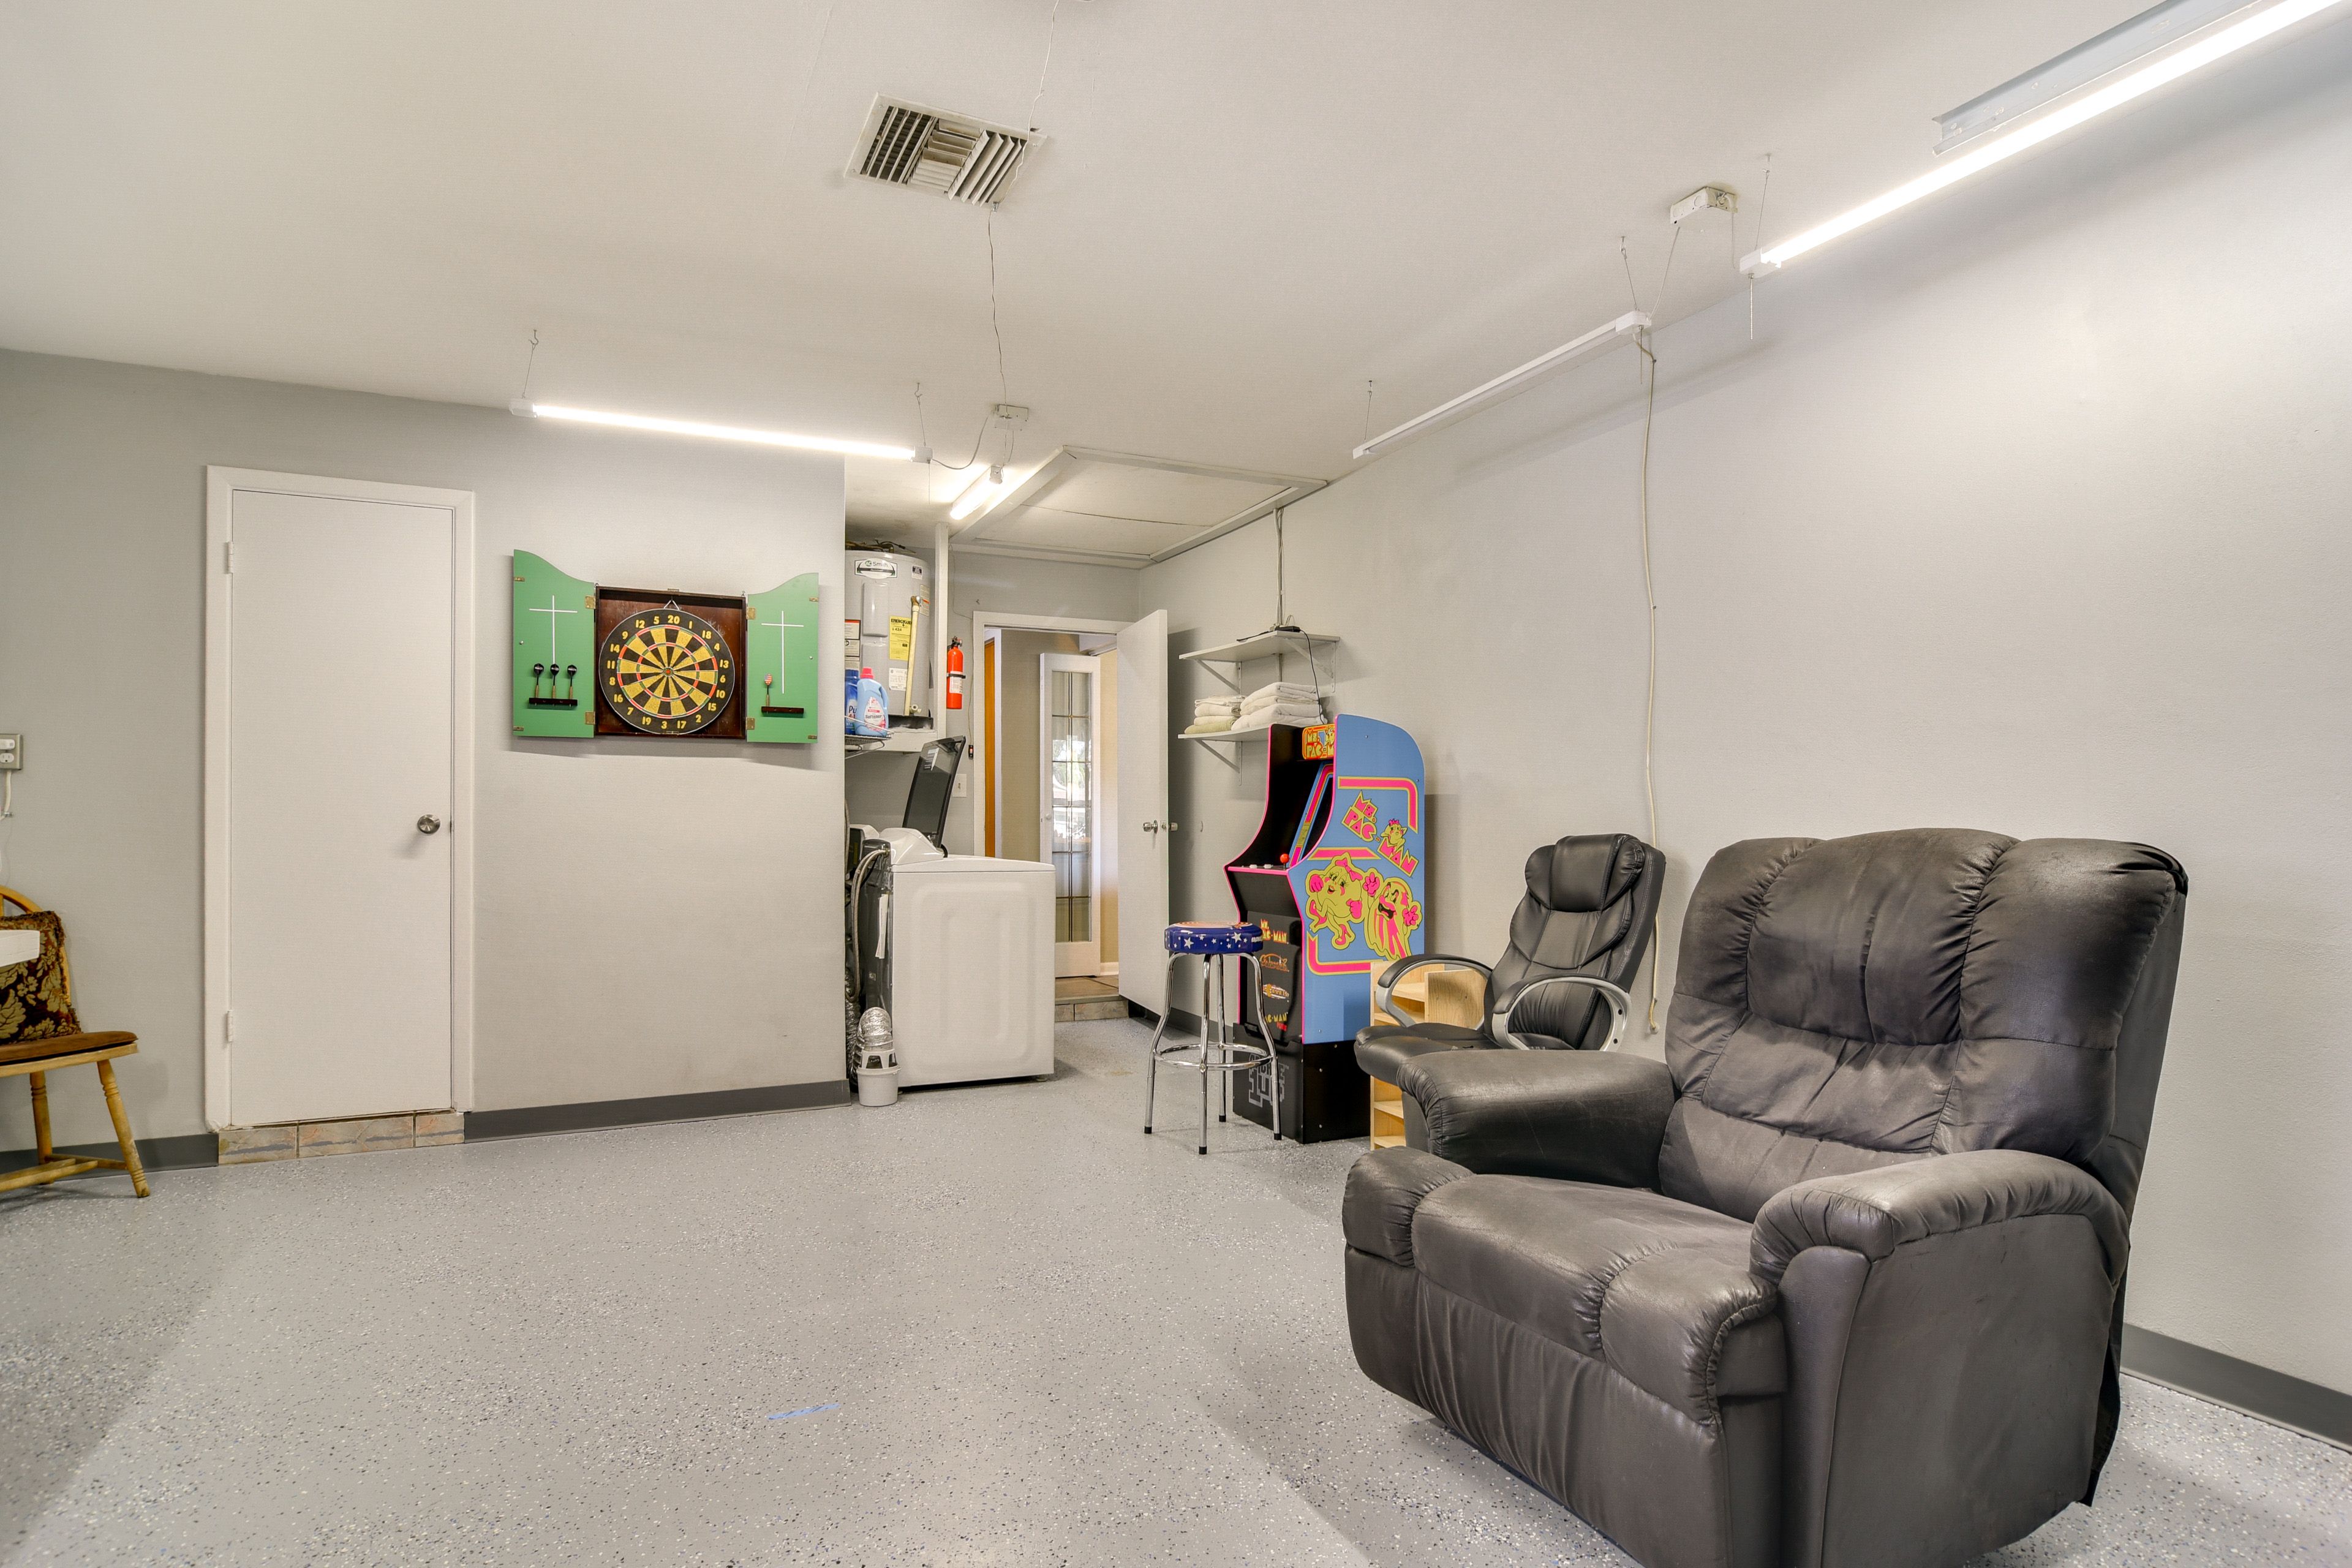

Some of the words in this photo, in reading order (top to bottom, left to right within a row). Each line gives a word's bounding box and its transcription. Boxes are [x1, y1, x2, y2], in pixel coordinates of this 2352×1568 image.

[635, 619, 645, 628] 12
[653, 616, 660, 624] 5
[667, 615, 680, 624] 20
[688, 620, 693, 629] 1
[622, 631, 628, 639] 9
[702, 630, 711, 639] 18
[610, 644, 620, 653] 14
[714, 643, 720, 651] 4
[607, 660, 615, 669] 11
[719, 659, 729, 668] 13
[609, 677, 616, 685] 8
[614, 694, 624, 703] 16
[715, 690, 725, 698] 10
[627, 707, 634, 715] 7
[707, 703, 717, 711] 15
[642, 716, 651, 725] 19
[695, 714, 701, 723] 2
[661, 720, 668, 729] 3
[677, 720, 687, 729] 17
